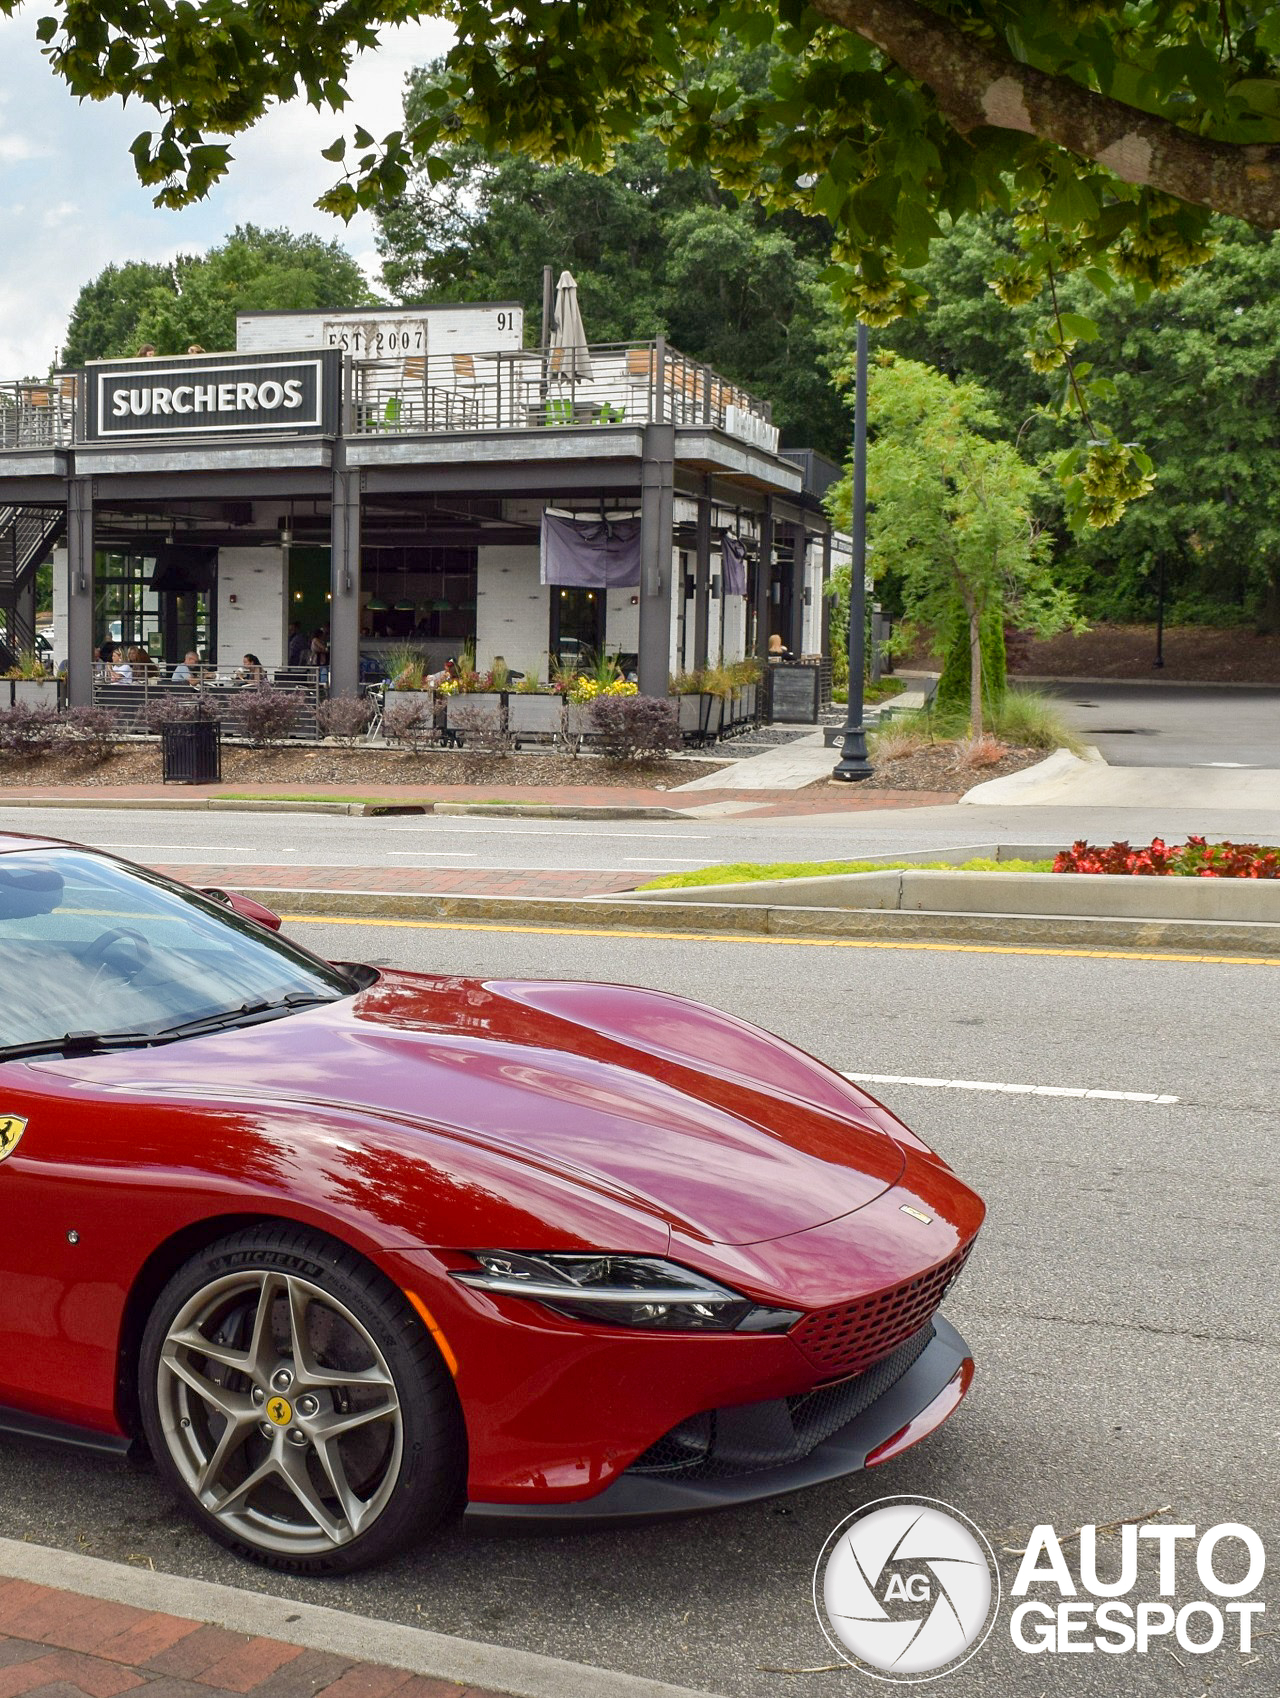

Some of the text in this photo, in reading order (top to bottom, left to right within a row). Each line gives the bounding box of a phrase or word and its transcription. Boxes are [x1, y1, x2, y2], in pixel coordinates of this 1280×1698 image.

[497, 312, 514, 331] 91
[376, 332, 422, 350] 2007
[113, 380, 303, 416] SURCHEROS
[231, 1252, 319, 1275] MICHELIN
